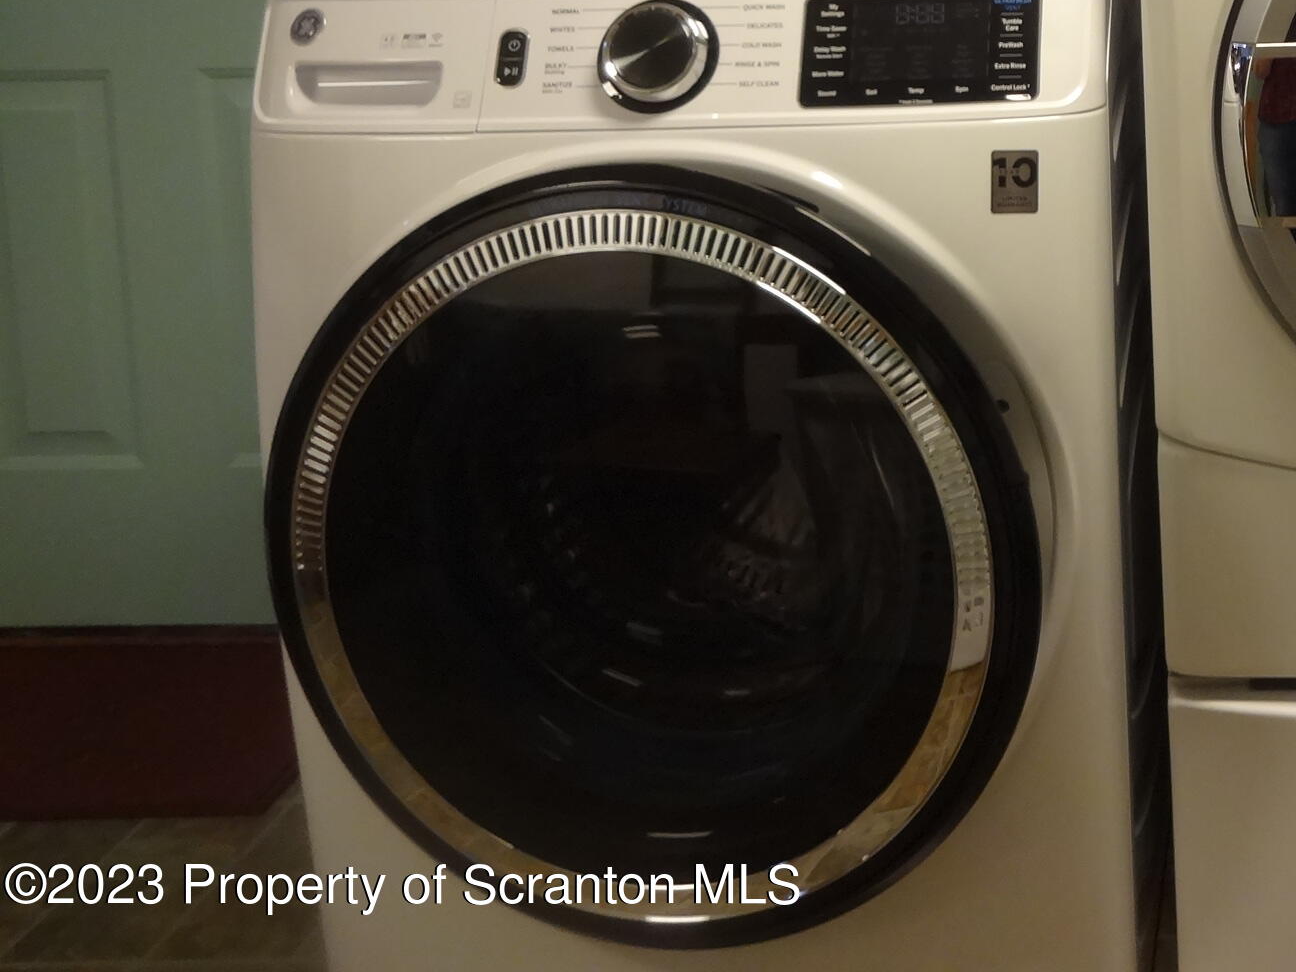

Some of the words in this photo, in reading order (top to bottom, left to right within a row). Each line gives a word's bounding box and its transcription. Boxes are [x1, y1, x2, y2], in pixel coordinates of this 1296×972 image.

[743, 3, 764, 11] QUICK
[735, 60, 755, 68] RINSE
[994, 62, 1009, 70] Extra
